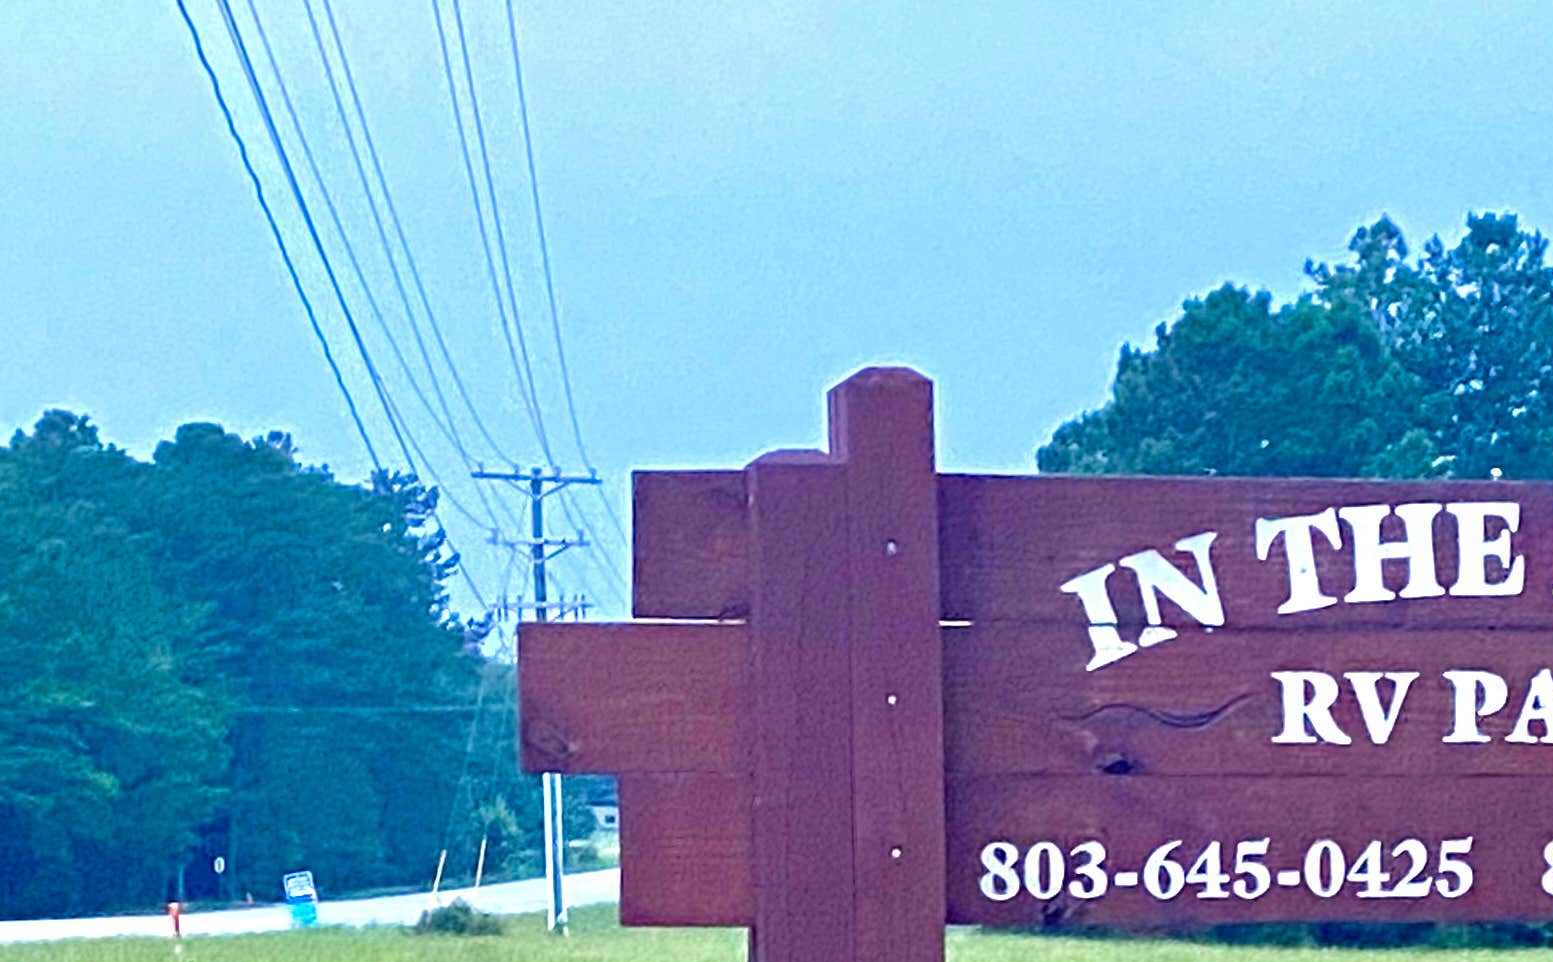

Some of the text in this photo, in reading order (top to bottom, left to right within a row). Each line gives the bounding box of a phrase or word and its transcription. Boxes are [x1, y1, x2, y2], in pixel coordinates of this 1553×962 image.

[1060, 532, 1224, 671] IN
[1256, 502, 1524, 614] THE
[1271, 671, 1420, 744] RV
[980, 837, 1473, 900] 803-645-0425
